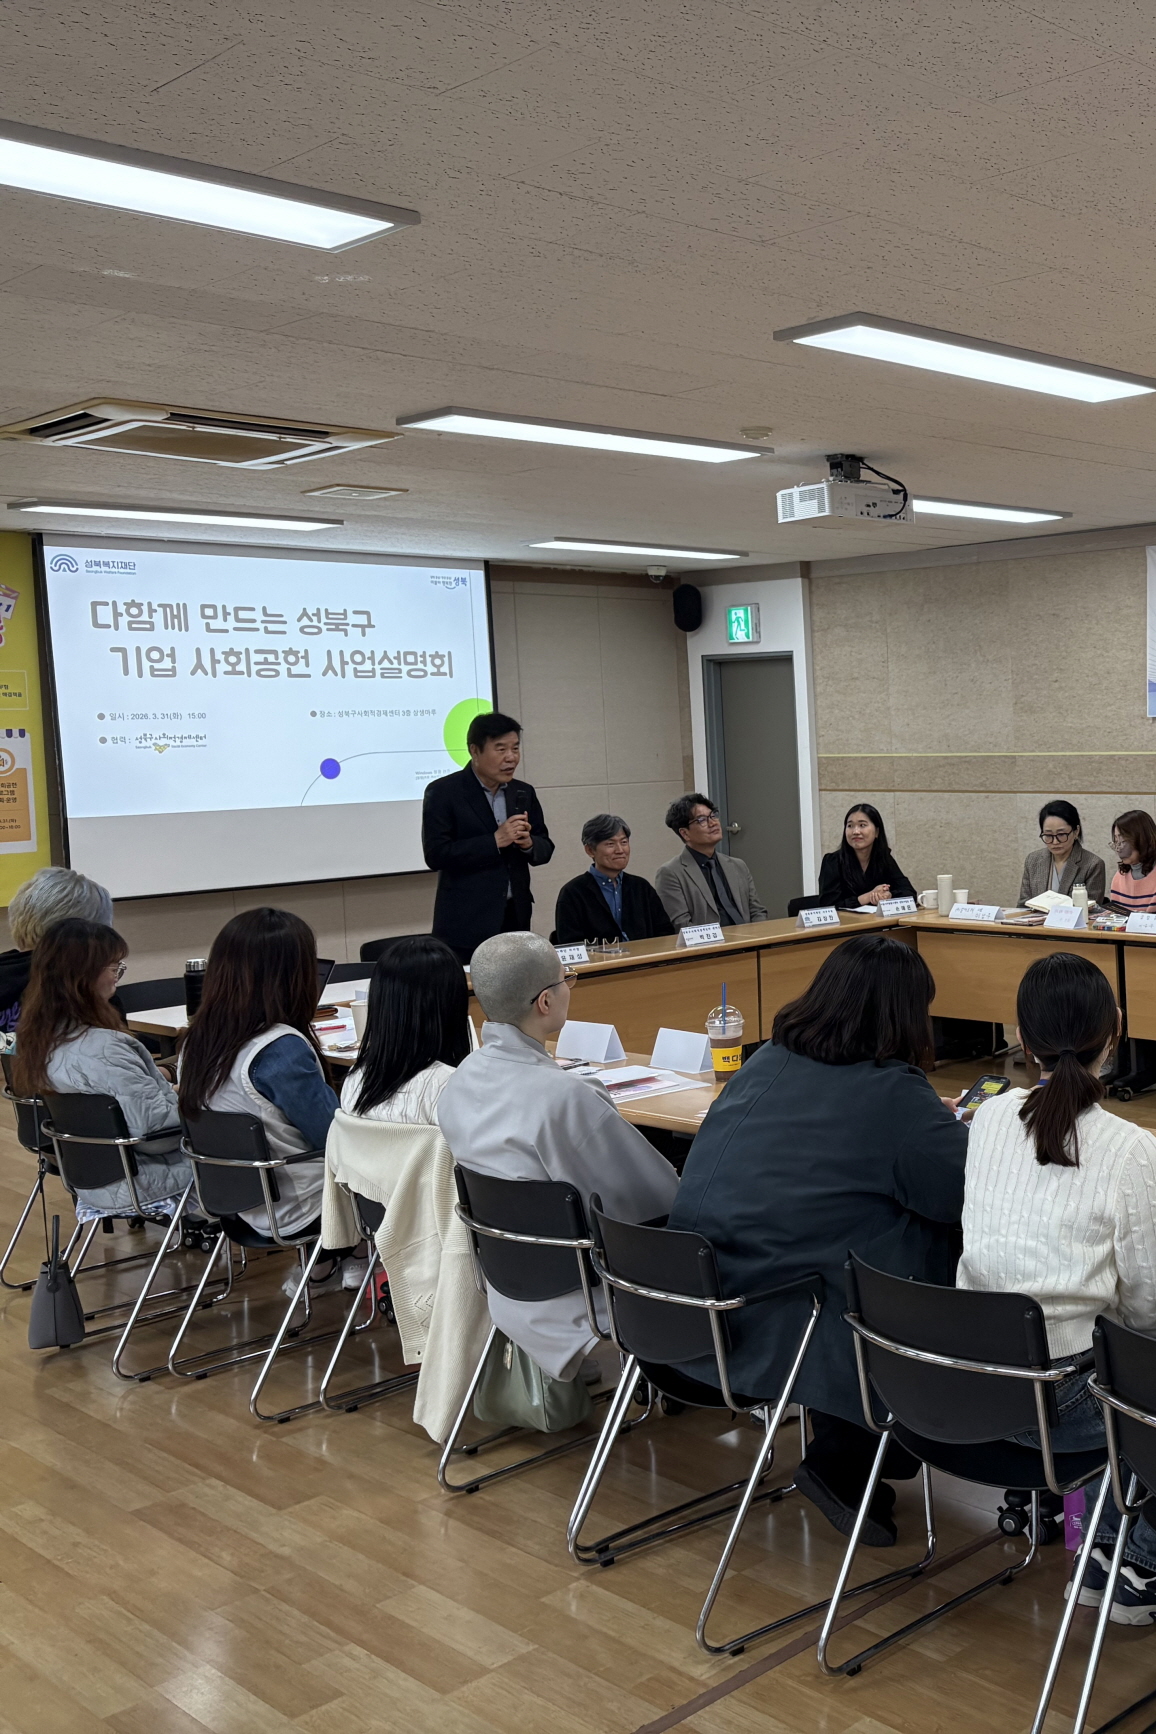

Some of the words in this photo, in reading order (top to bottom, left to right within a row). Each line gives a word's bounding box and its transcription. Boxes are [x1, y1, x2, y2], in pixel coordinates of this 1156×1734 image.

[85, 559, 136, 570] 성북복지재단
[453, 576, 467, 587] 성북
[90, 599, 189, 632] 다함께
[199, 603, 287, 635] 만드는
[296, 607, 376, 638] 성북구
[109, 645, 177, 679] 기업
[190, 646, 312, 679] 사회공헌
[321, 648, 454, 679] 사업설명회
[109, 712, 125, 721] 일시
[160, 712, 182, 720] 31(화)
[337, 709, 400, 718] 성북구사회적경제센터
[401, 709, 411, 717] 3층
